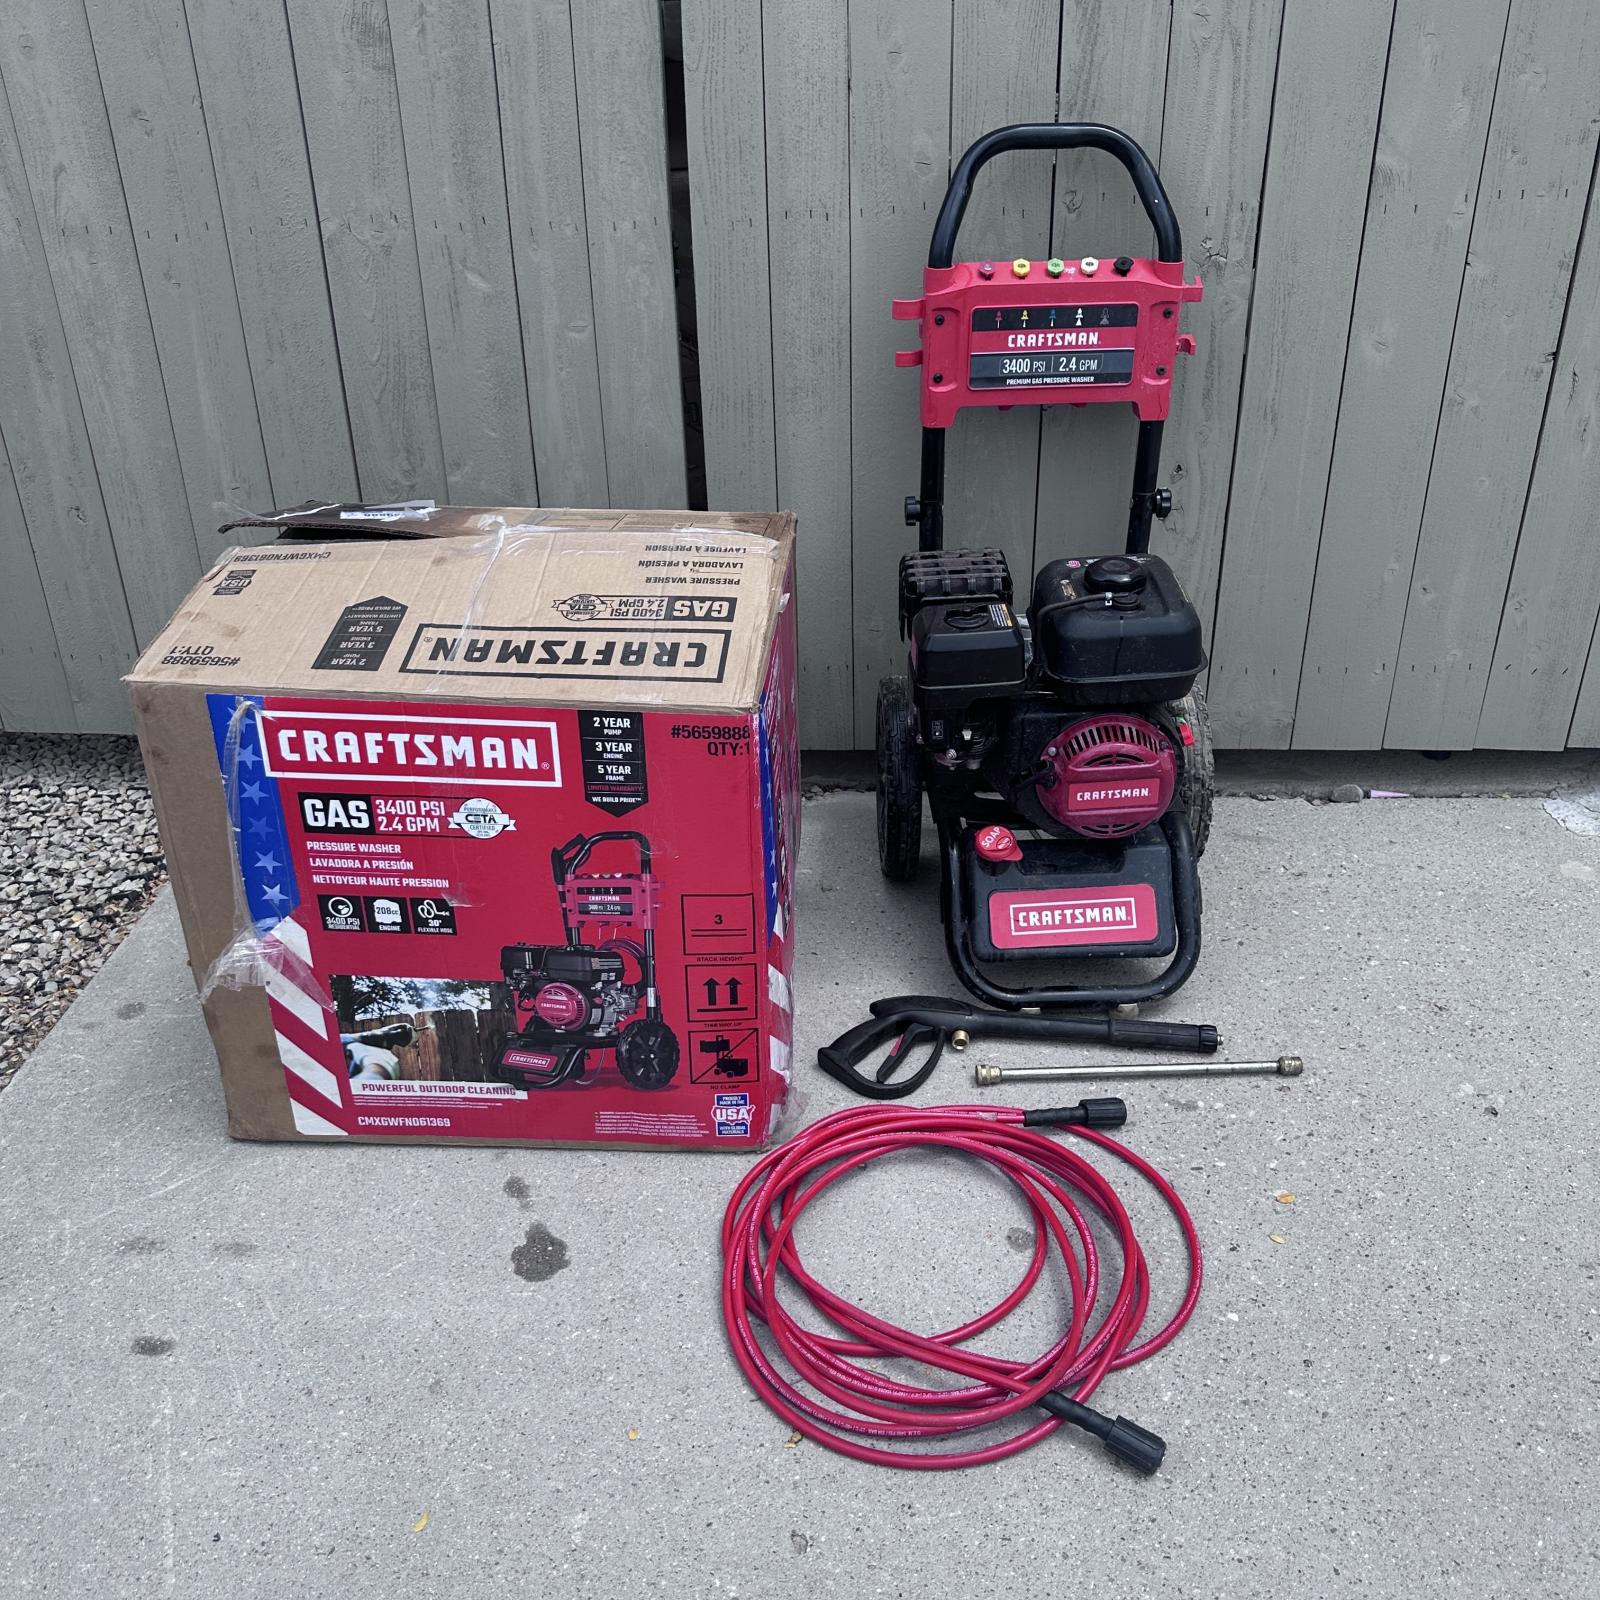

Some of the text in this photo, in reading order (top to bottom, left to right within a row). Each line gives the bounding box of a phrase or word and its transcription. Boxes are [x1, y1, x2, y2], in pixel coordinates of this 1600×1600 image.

[1008, 332, 1098, 347] CRAFTSMAN
[1003, 357, 1097, 373] 3400 PSI 2.4 GPM
[692, 561, 744, 569] LAVADORA
[618, 599, 664, 608] 2.4 GPM
[672, 600, 730, 618] GAS
[610, 608, 662, 617] 3400 PSI
[169, 646, 214, 655] QTY:1
[161, 656, 240, 666] #5659888
[594, 718, 630, 728] 2 YEAR
[671, 725, 750, 740] #5659888
[596, 742, 632, 752] 3 YEAR
[598, 765, 631, 774] 5 YEAR
[1077, 788, 1149, 801] CRAFTSMAN
[304, 798, 370, 828] GAS
[376, 800, 445, 816] 3400 PSI
[378, 816, 440, 832] 2.4 GPM
[465, 814, 496, 823] CETA
[982, 826, 1001, 847] SOAP
[307, 841, 401, 853] PRESSURE WASHER
[310, 858, 413, 870] LAVADORA A PRESIÓN
[313, 875, 449, 888] NETTOYEUR HAUTE PRESSION
[376, 907, 399, 915] 208cc
[1019, 906, 1126, 926] CRAFTSMAN
[714, 915, 723, 924] 3
[512, 1055, 547, 1065] CRAFTSMAN
[362, 1083, 516, 1095] POWERFUL OUTDOOR CLEANING
[716, 1108, 749, 1120] USA
[358, 1116, 450, 1126] CMXGWFN061369
